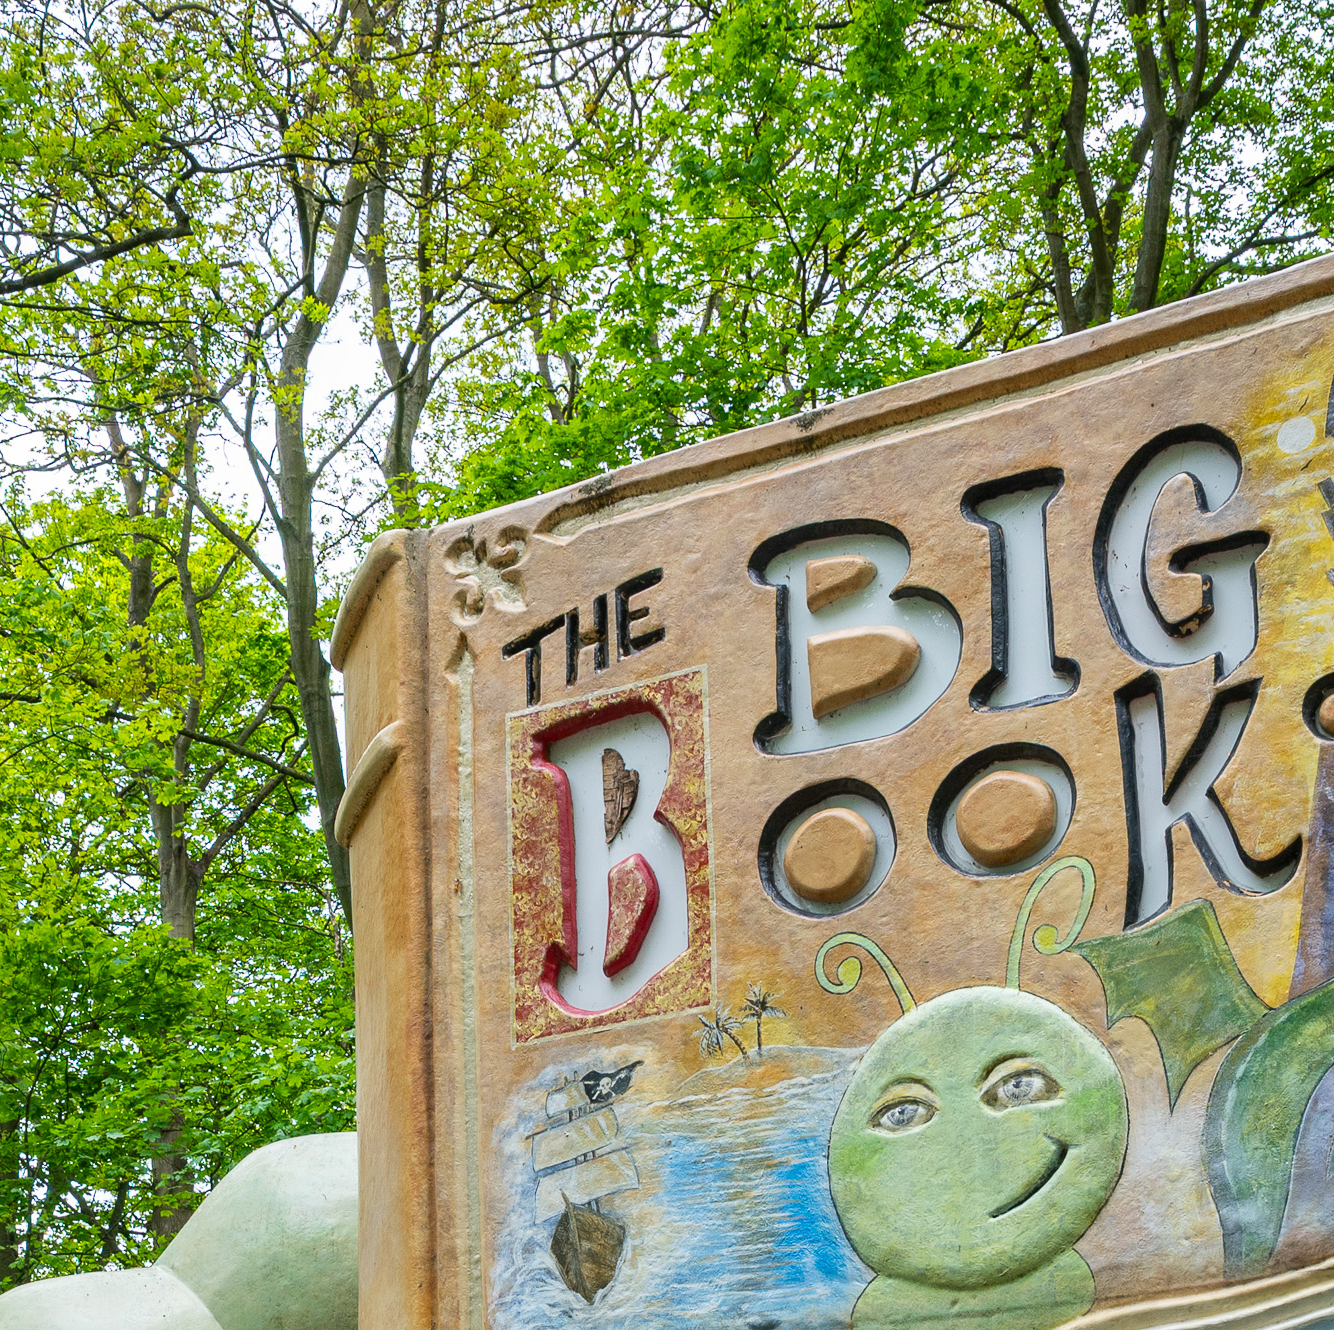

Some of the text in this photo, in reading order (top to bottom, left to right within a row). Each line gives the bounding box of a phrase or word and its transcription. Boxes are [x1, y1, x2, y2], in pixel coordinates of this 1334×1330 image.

[502, 423, 1269, 757] THE BIG
[531, 672, 1303, 1016] BOOK
